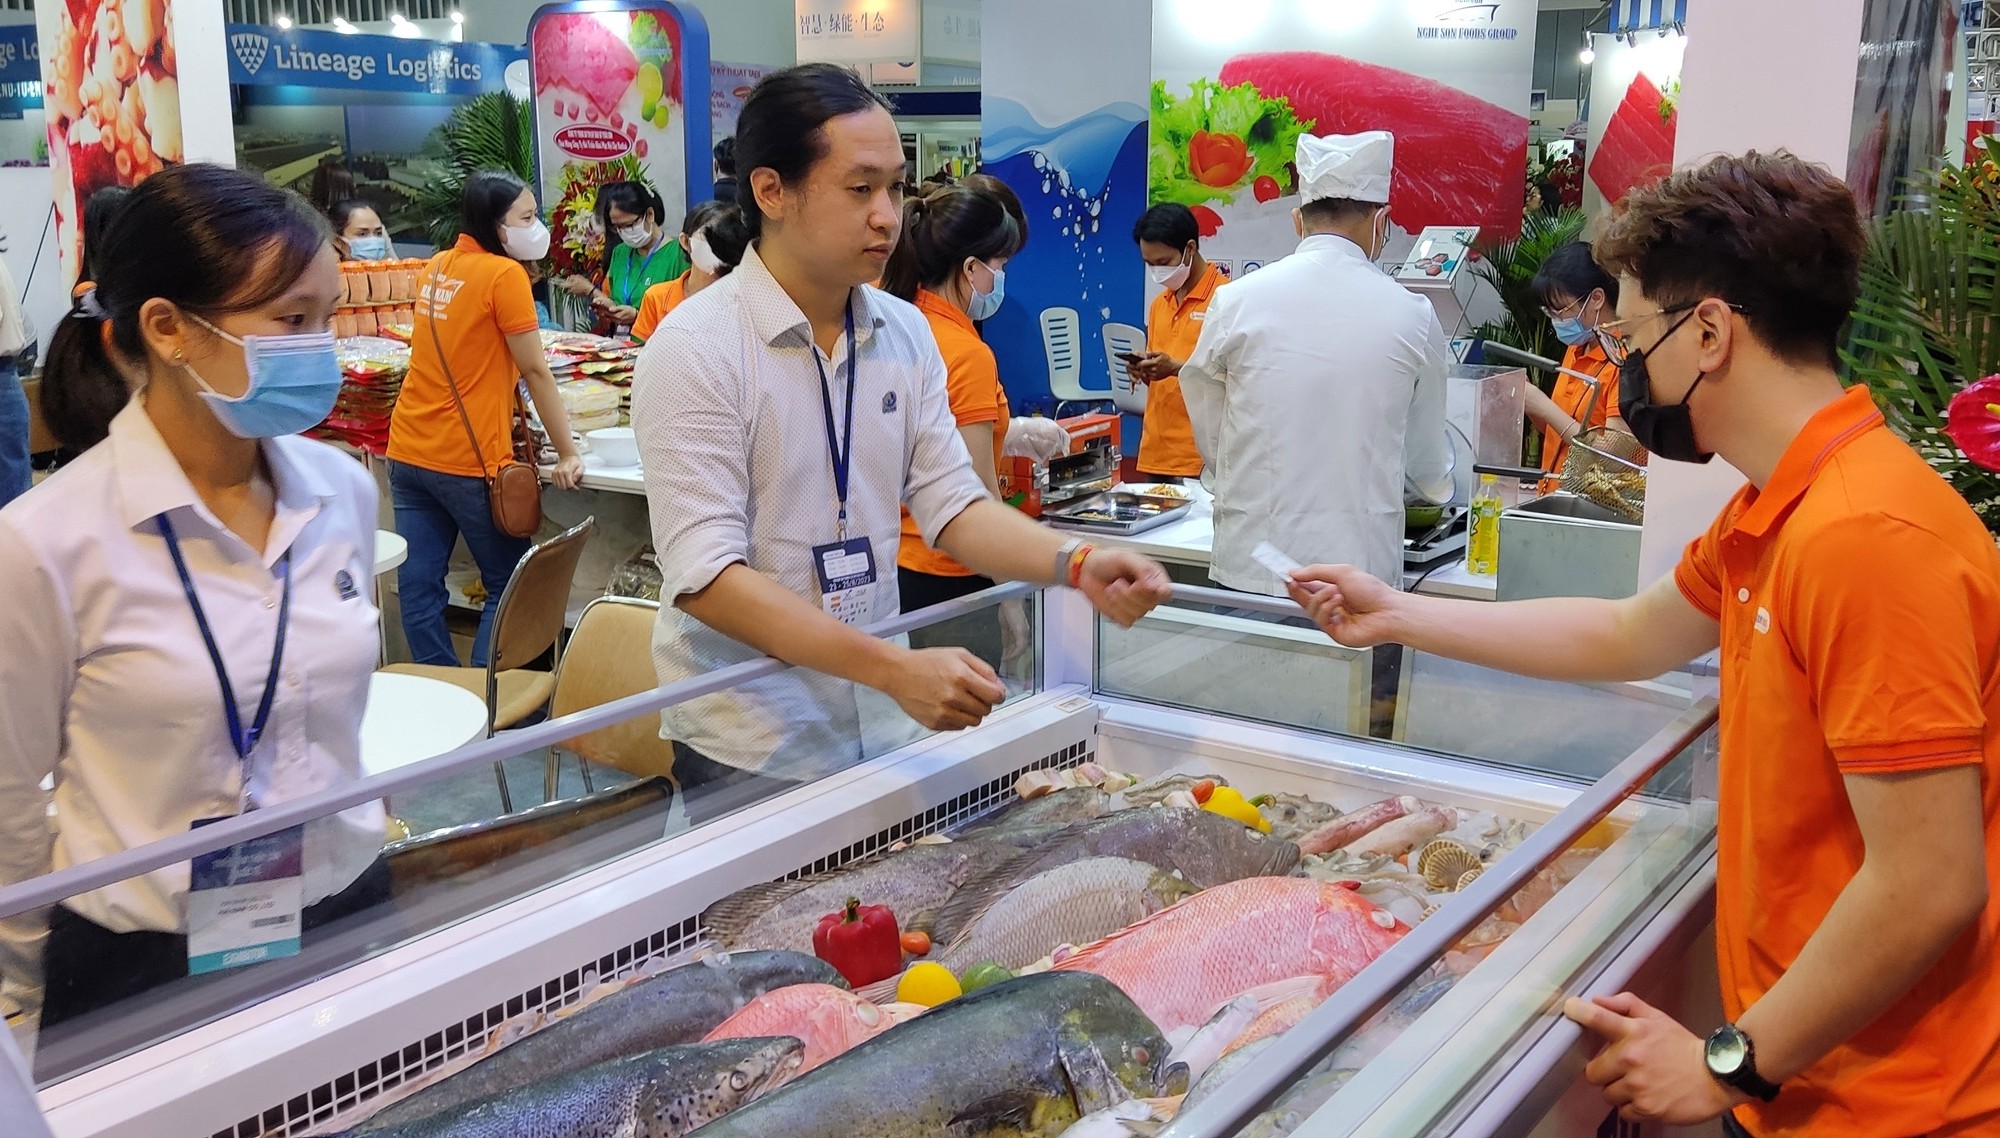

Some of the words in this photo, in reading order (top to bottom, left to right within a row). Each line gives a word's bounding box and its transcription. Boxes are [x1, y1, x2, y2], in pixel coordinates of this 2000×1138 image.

[1458, 28, 1487, 40] FOODS
[1487, 28, 1518, 41] GROUP
[273, 44, 376, 81] Lineage
